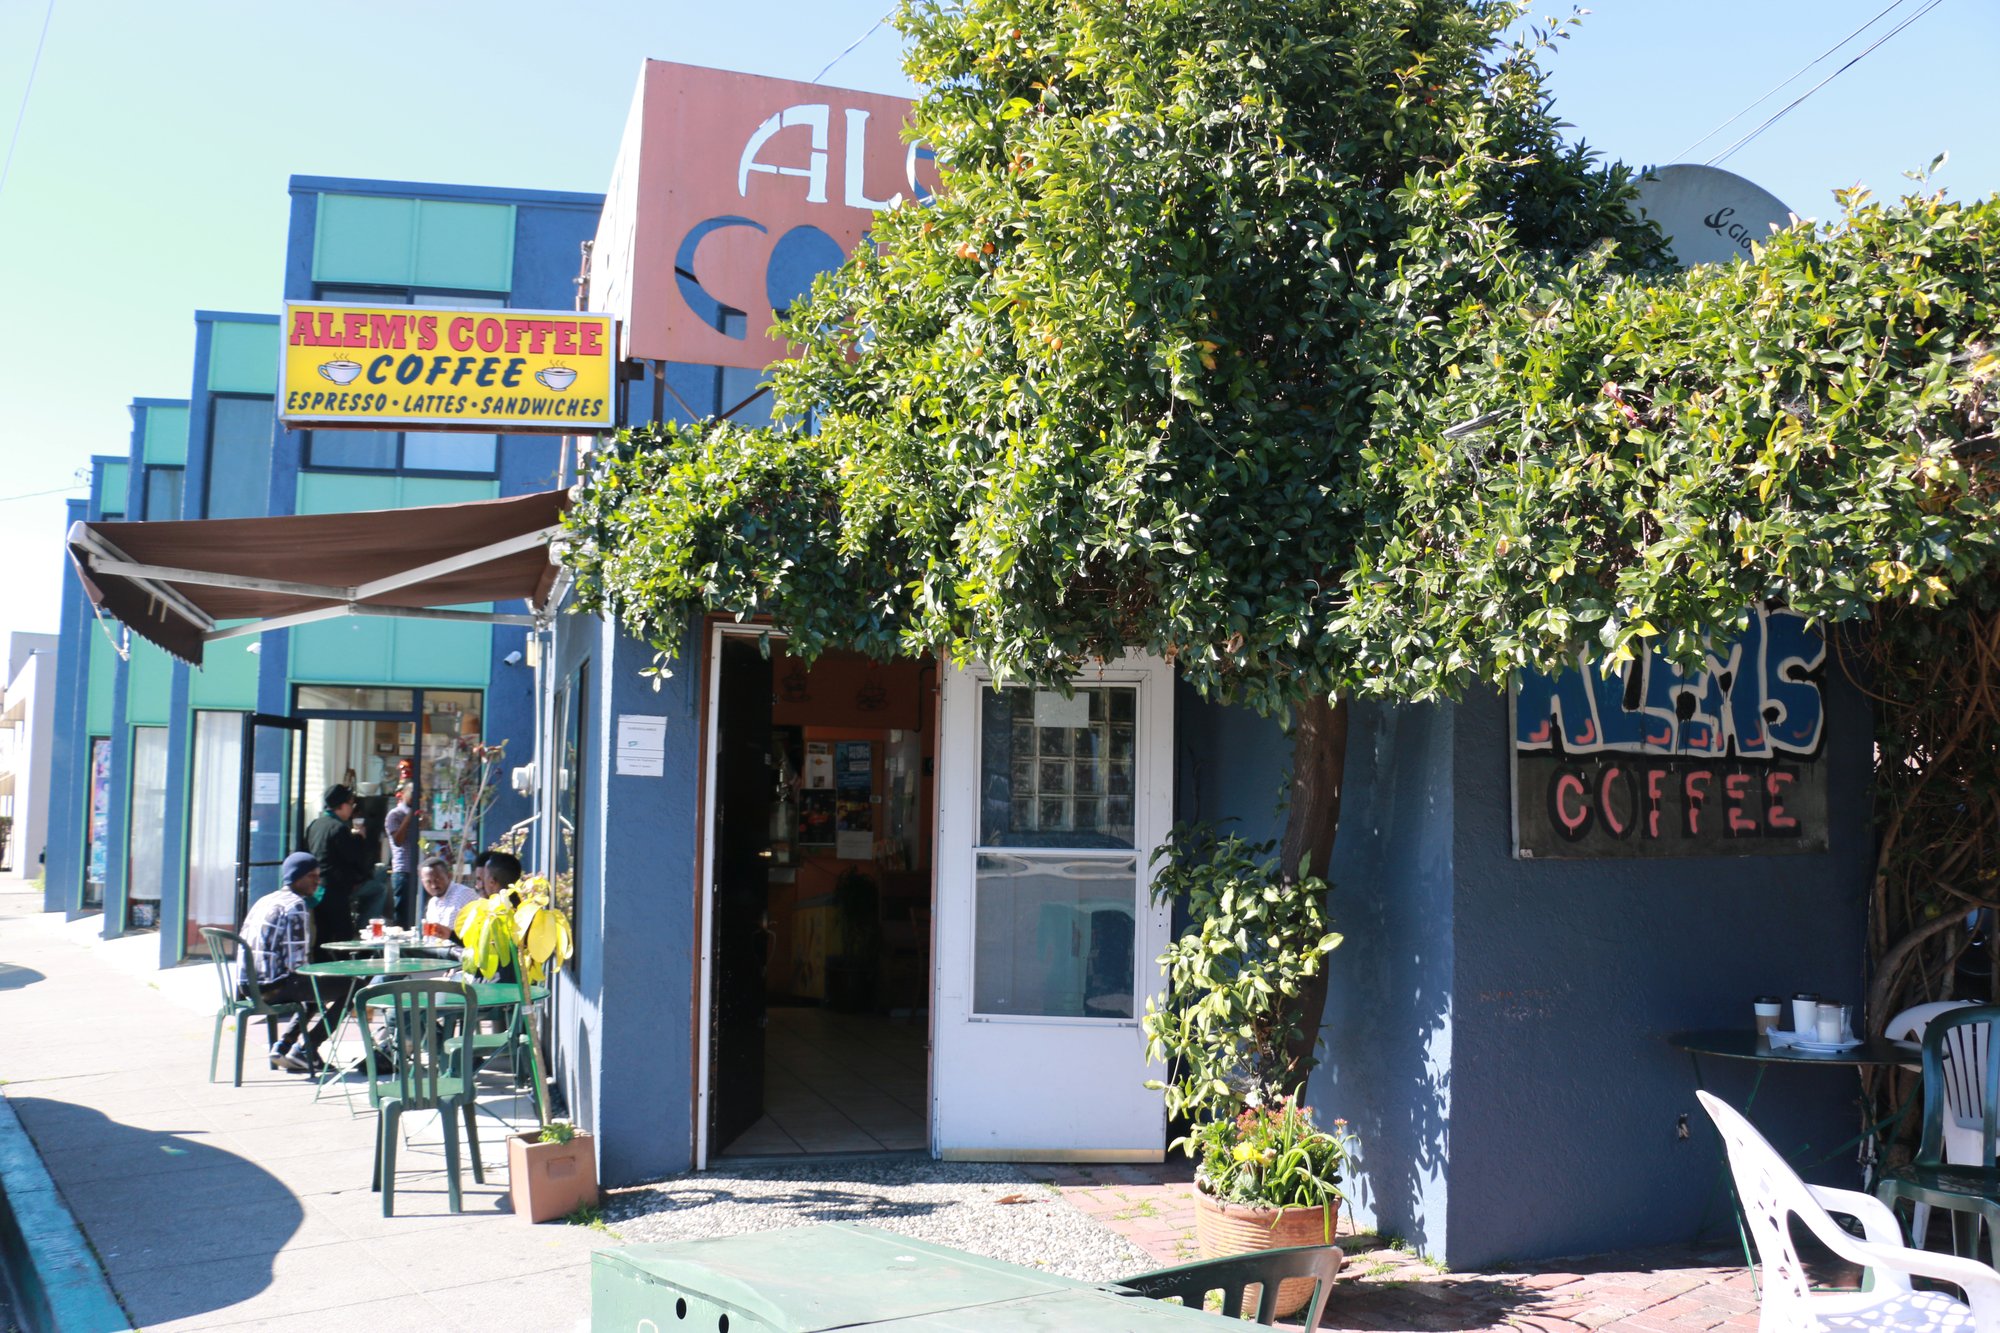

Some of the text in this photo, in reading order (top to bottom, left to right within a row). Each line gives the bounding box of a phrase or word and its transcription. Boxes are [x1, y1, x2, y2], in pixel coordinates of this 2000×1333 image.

[290, 311, 603, 356] ALEM'S COFFEE
[367, 353, 527, 388] COFFEE
[287, 391, 603, 417] ESPRESSO LATTES SANDWICHES
[1547, 763, 1802, 841] COFFEE
